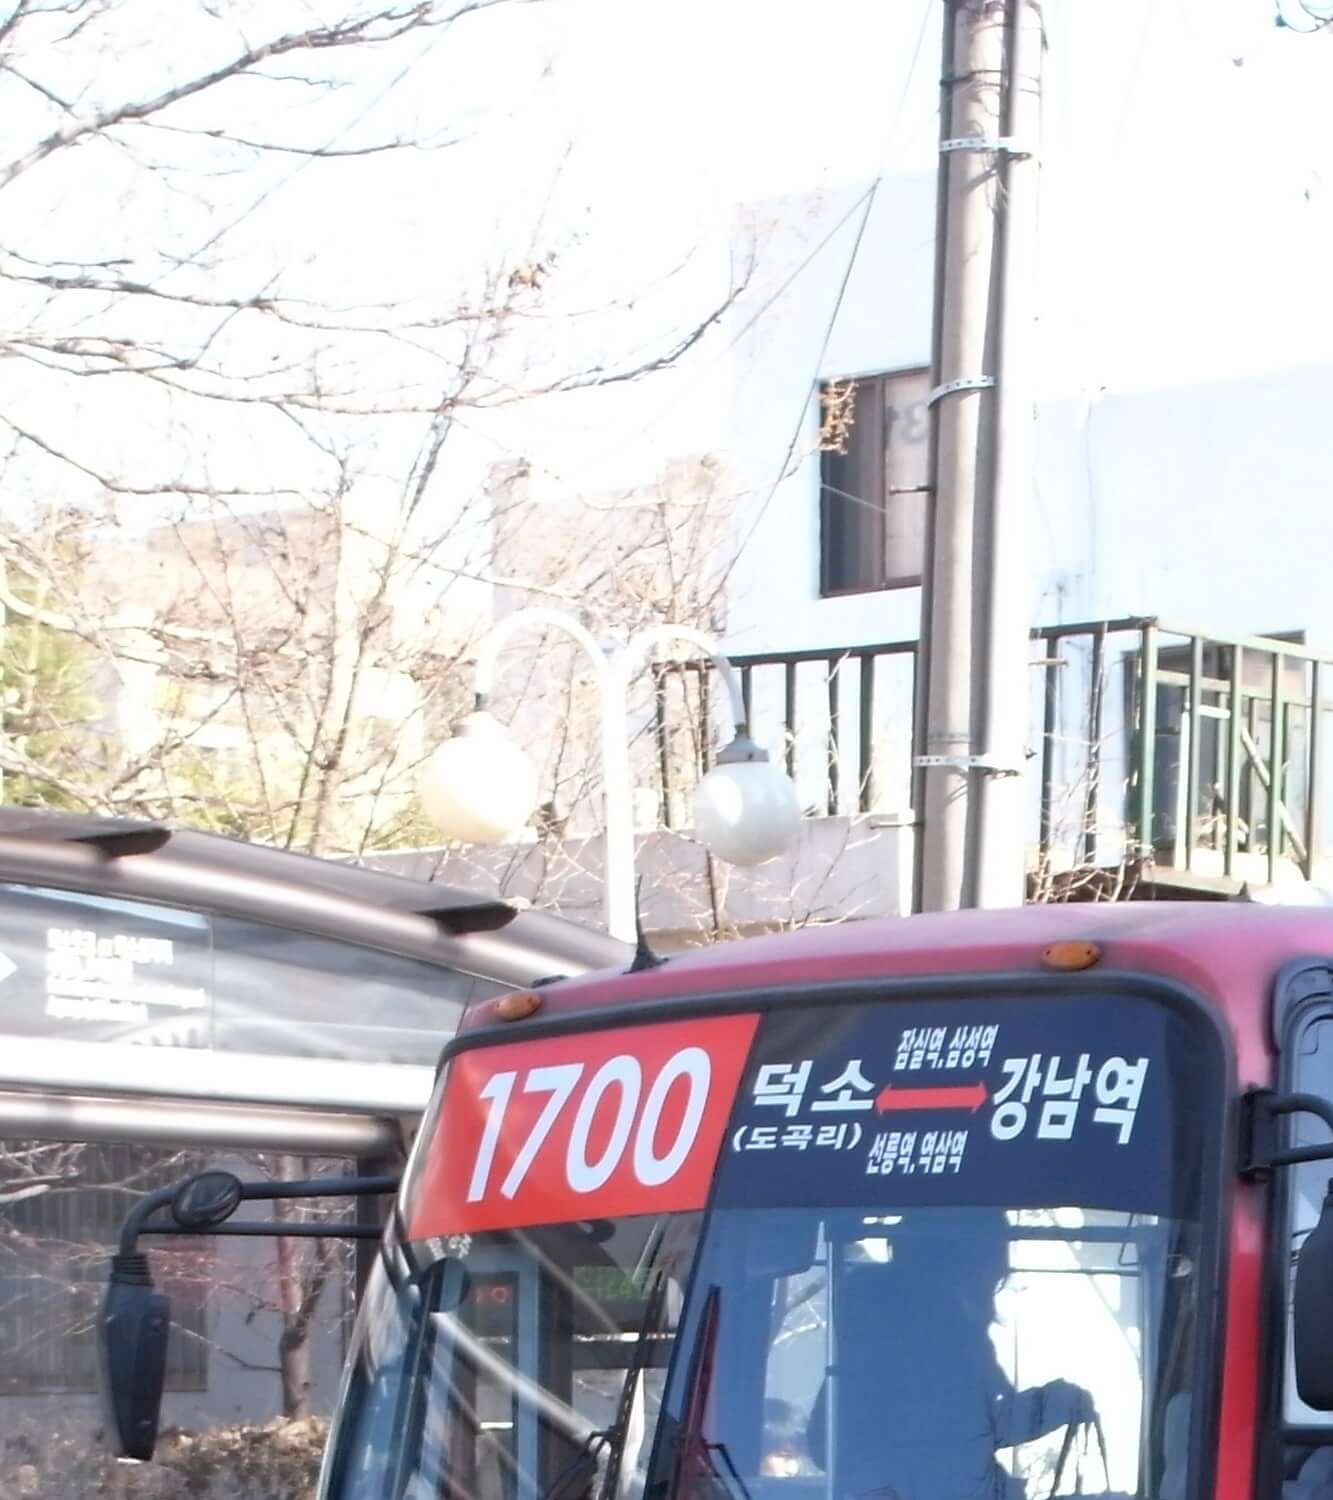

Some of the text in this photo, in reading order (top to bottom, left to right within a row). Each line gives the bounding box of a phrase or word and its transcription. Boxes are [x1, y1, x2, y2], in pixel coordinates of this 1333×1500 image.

[466, 1046, 711, 1204] 1700
[732, 1122, 864, 1154] (도곡리)
[752, 1053, 1150, 1145] 덕소 강남역
